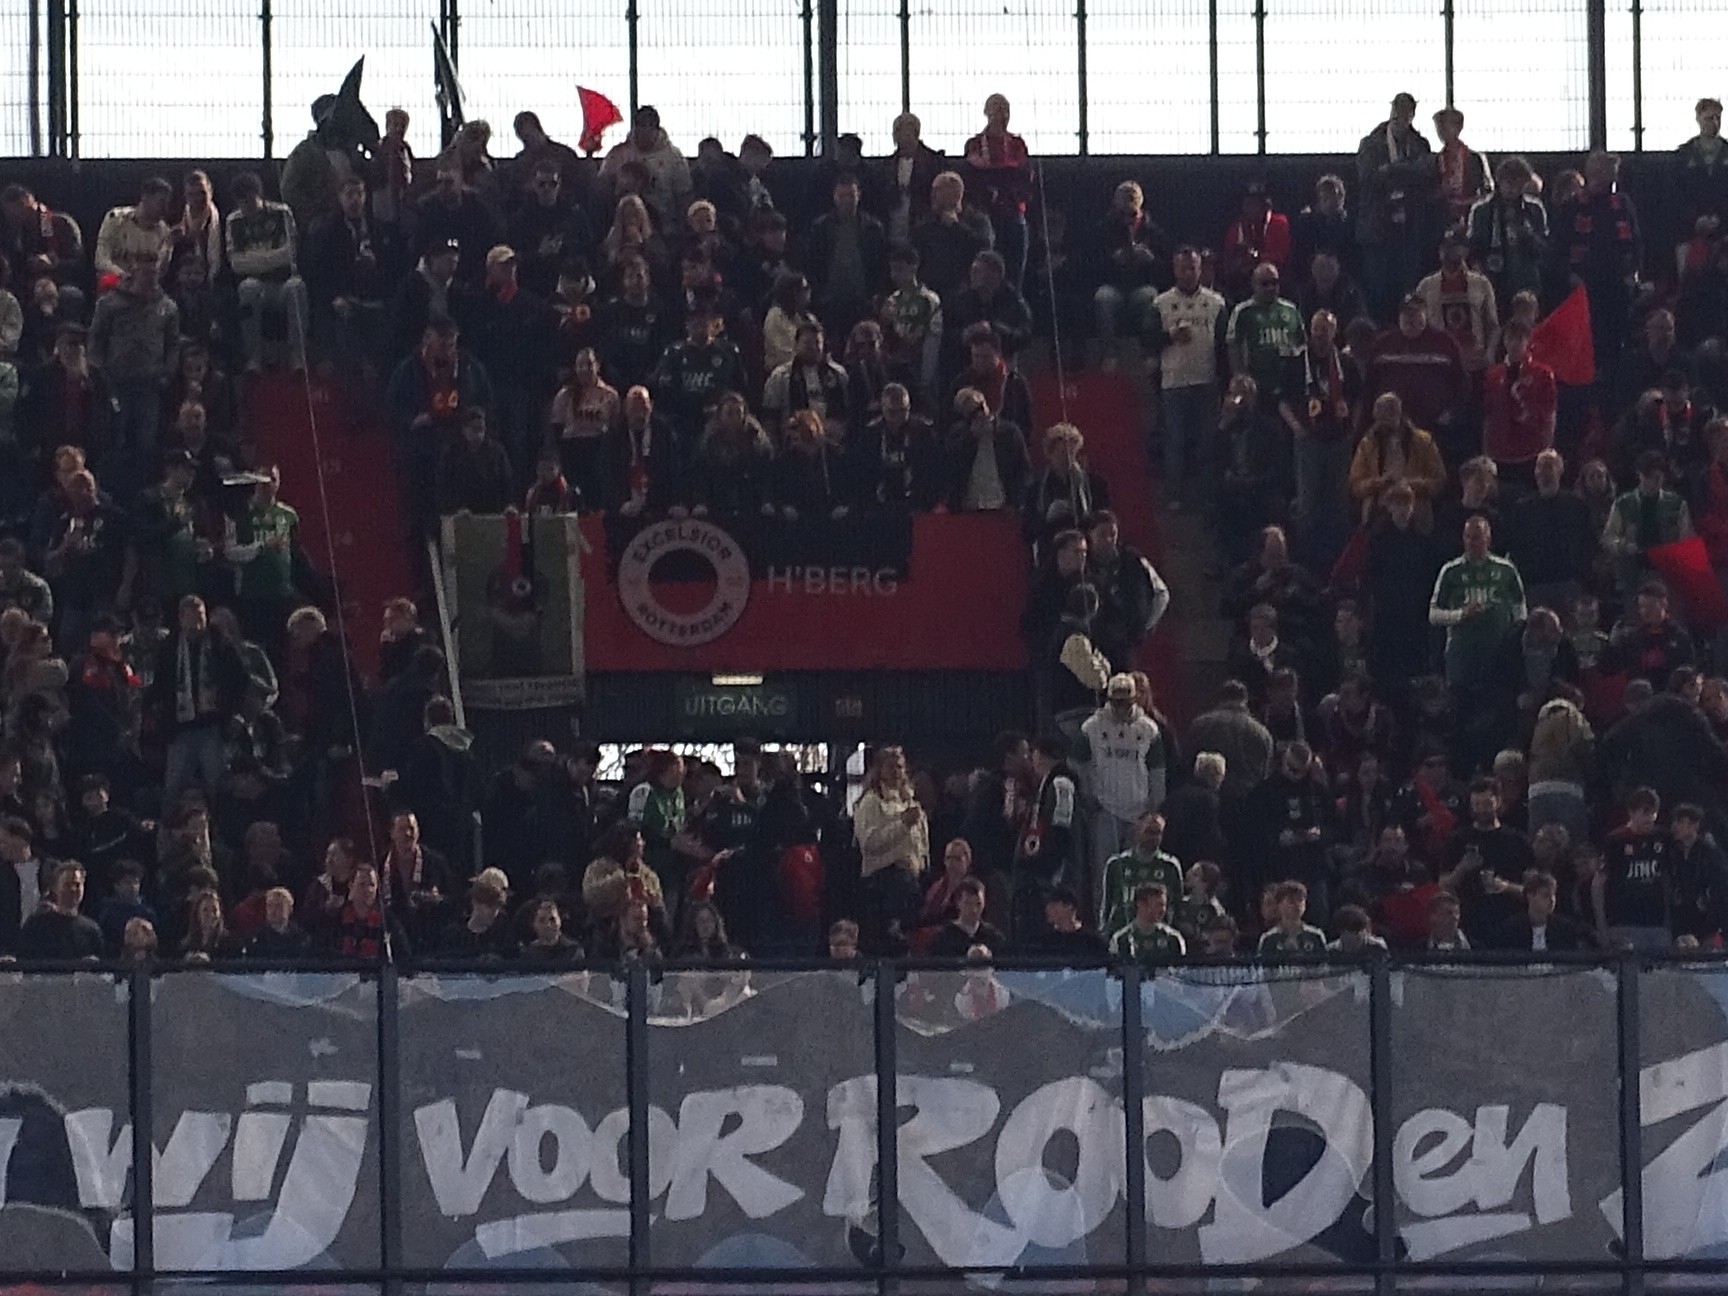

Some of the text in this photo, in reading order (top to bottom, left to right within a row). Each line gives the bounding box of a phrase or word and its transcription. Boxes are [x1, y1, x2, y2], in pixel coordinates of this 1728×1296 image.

[633, 529, 732, 564] EXCELSIOR
[768, 564, 898, 596] H'BERG
[684, 695, 789, 716] UITGANG
[64, 1080, 371, 1272] wij
[1391, 1104, 1572, 1226] en
